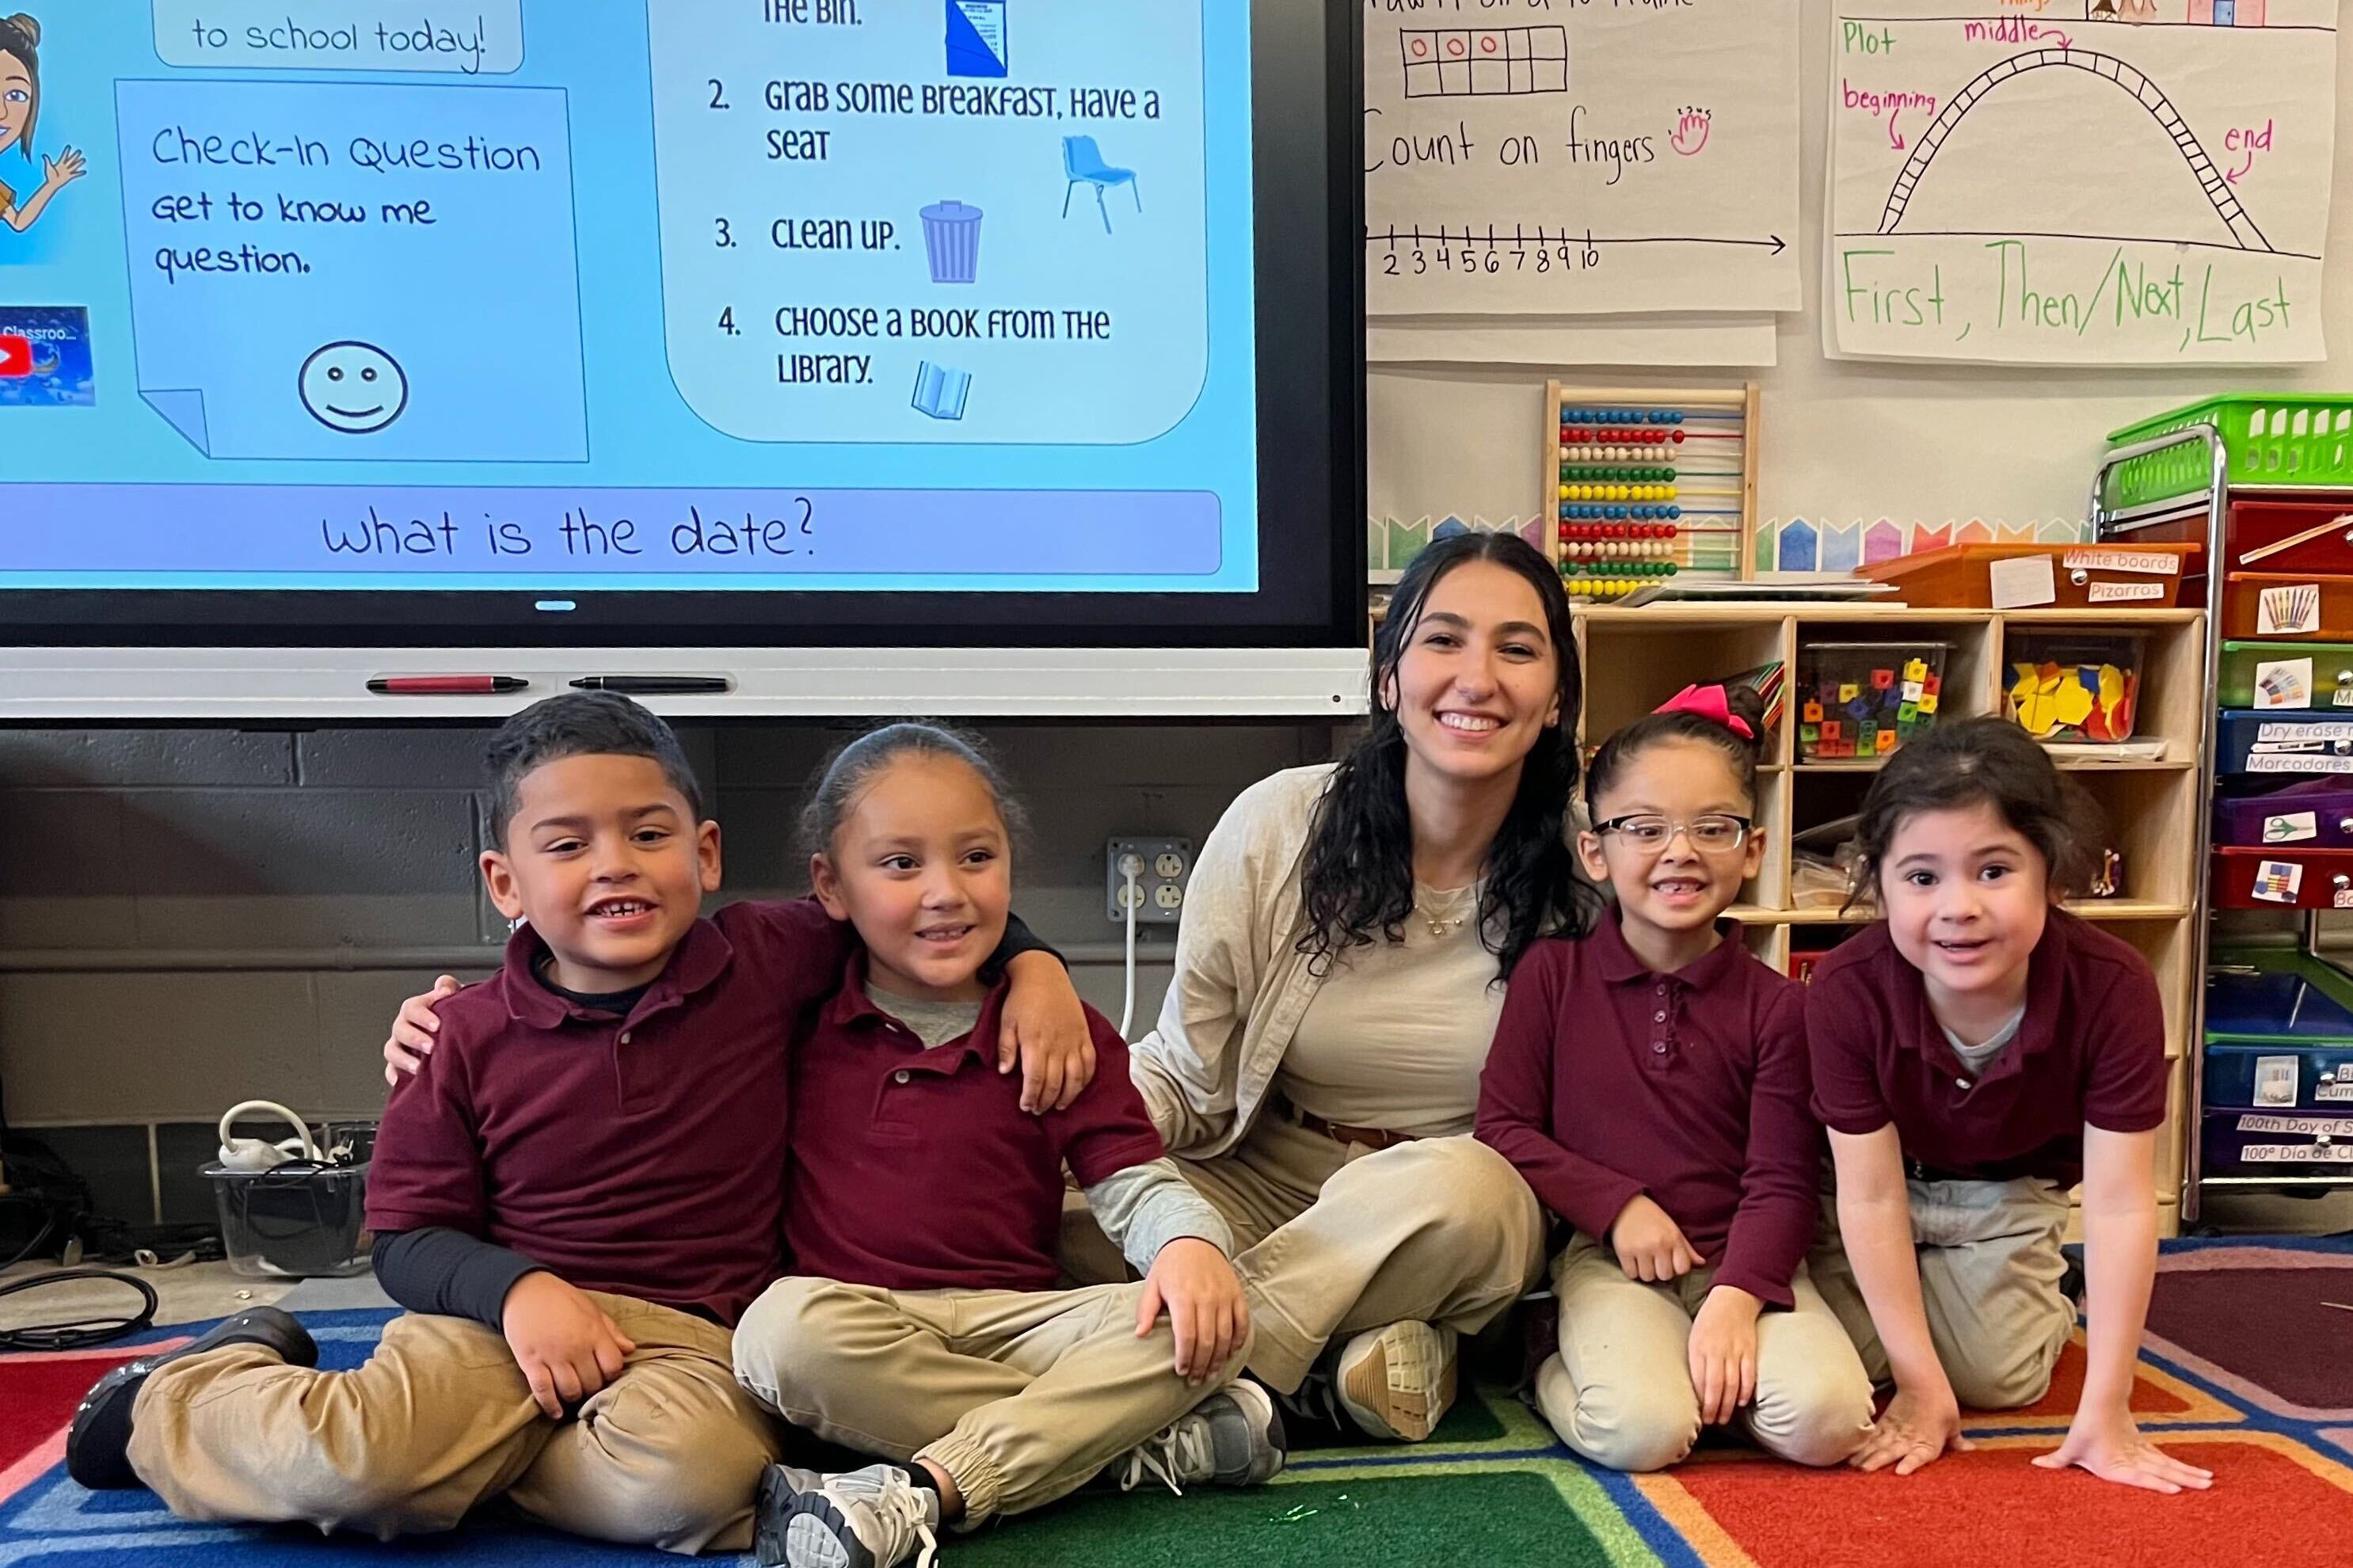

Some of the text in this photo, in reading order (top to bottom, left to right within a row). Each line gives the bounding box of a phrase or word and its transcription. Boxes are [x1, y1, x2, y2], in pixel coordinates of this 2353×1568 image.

[192, 15, 486, 75] to school today!
[1844, 21, 1897, 55] Plot
[1964, 14, 2040, 43] middle
[708, 79, 730, 109] 2.
[1144, 89, 1160, 120] a
[1843, 78, 1936, 116] beginning
[152, 125, 540, 173] Check-In Question
[1500, 136, 1538, 166] on
[1565, 105, 1654, 185] fingers
[2225, 118, 2272, 152] end
[151, 191, 438, 225] Get to know me
[715, 217, 737, 248] 3.
[154, 243, 311, 285] question.
[1384, 246, 1599, 276] 2 3 4 5 6 7 8 9 10
[1843, 250, 1971, 342] First,
[2197, 263, 2291, 344] Last
[718, 306, 741, 335] 4.
[886, 308, 903, 337] a
[484, 513, 531, 554] is
[559, 507, 642, 554] the
[672, 497, 813, 554] date?
[2066, 550, 2176, 570] White boards
[2091, 584, 2160, 598] Pizarras
[2336, 689, 2353, 704] M
[2261, 725, 2292, 739] Dry
[2296, 725, 2342, 737] erase
[2248, 756, 2351, 771] Marcadores
[2241, 1117, 2281, 1130] 100th
[2286, 1119, 2318, 1133] Day
[2322, 1120, 2340, 1132] of
